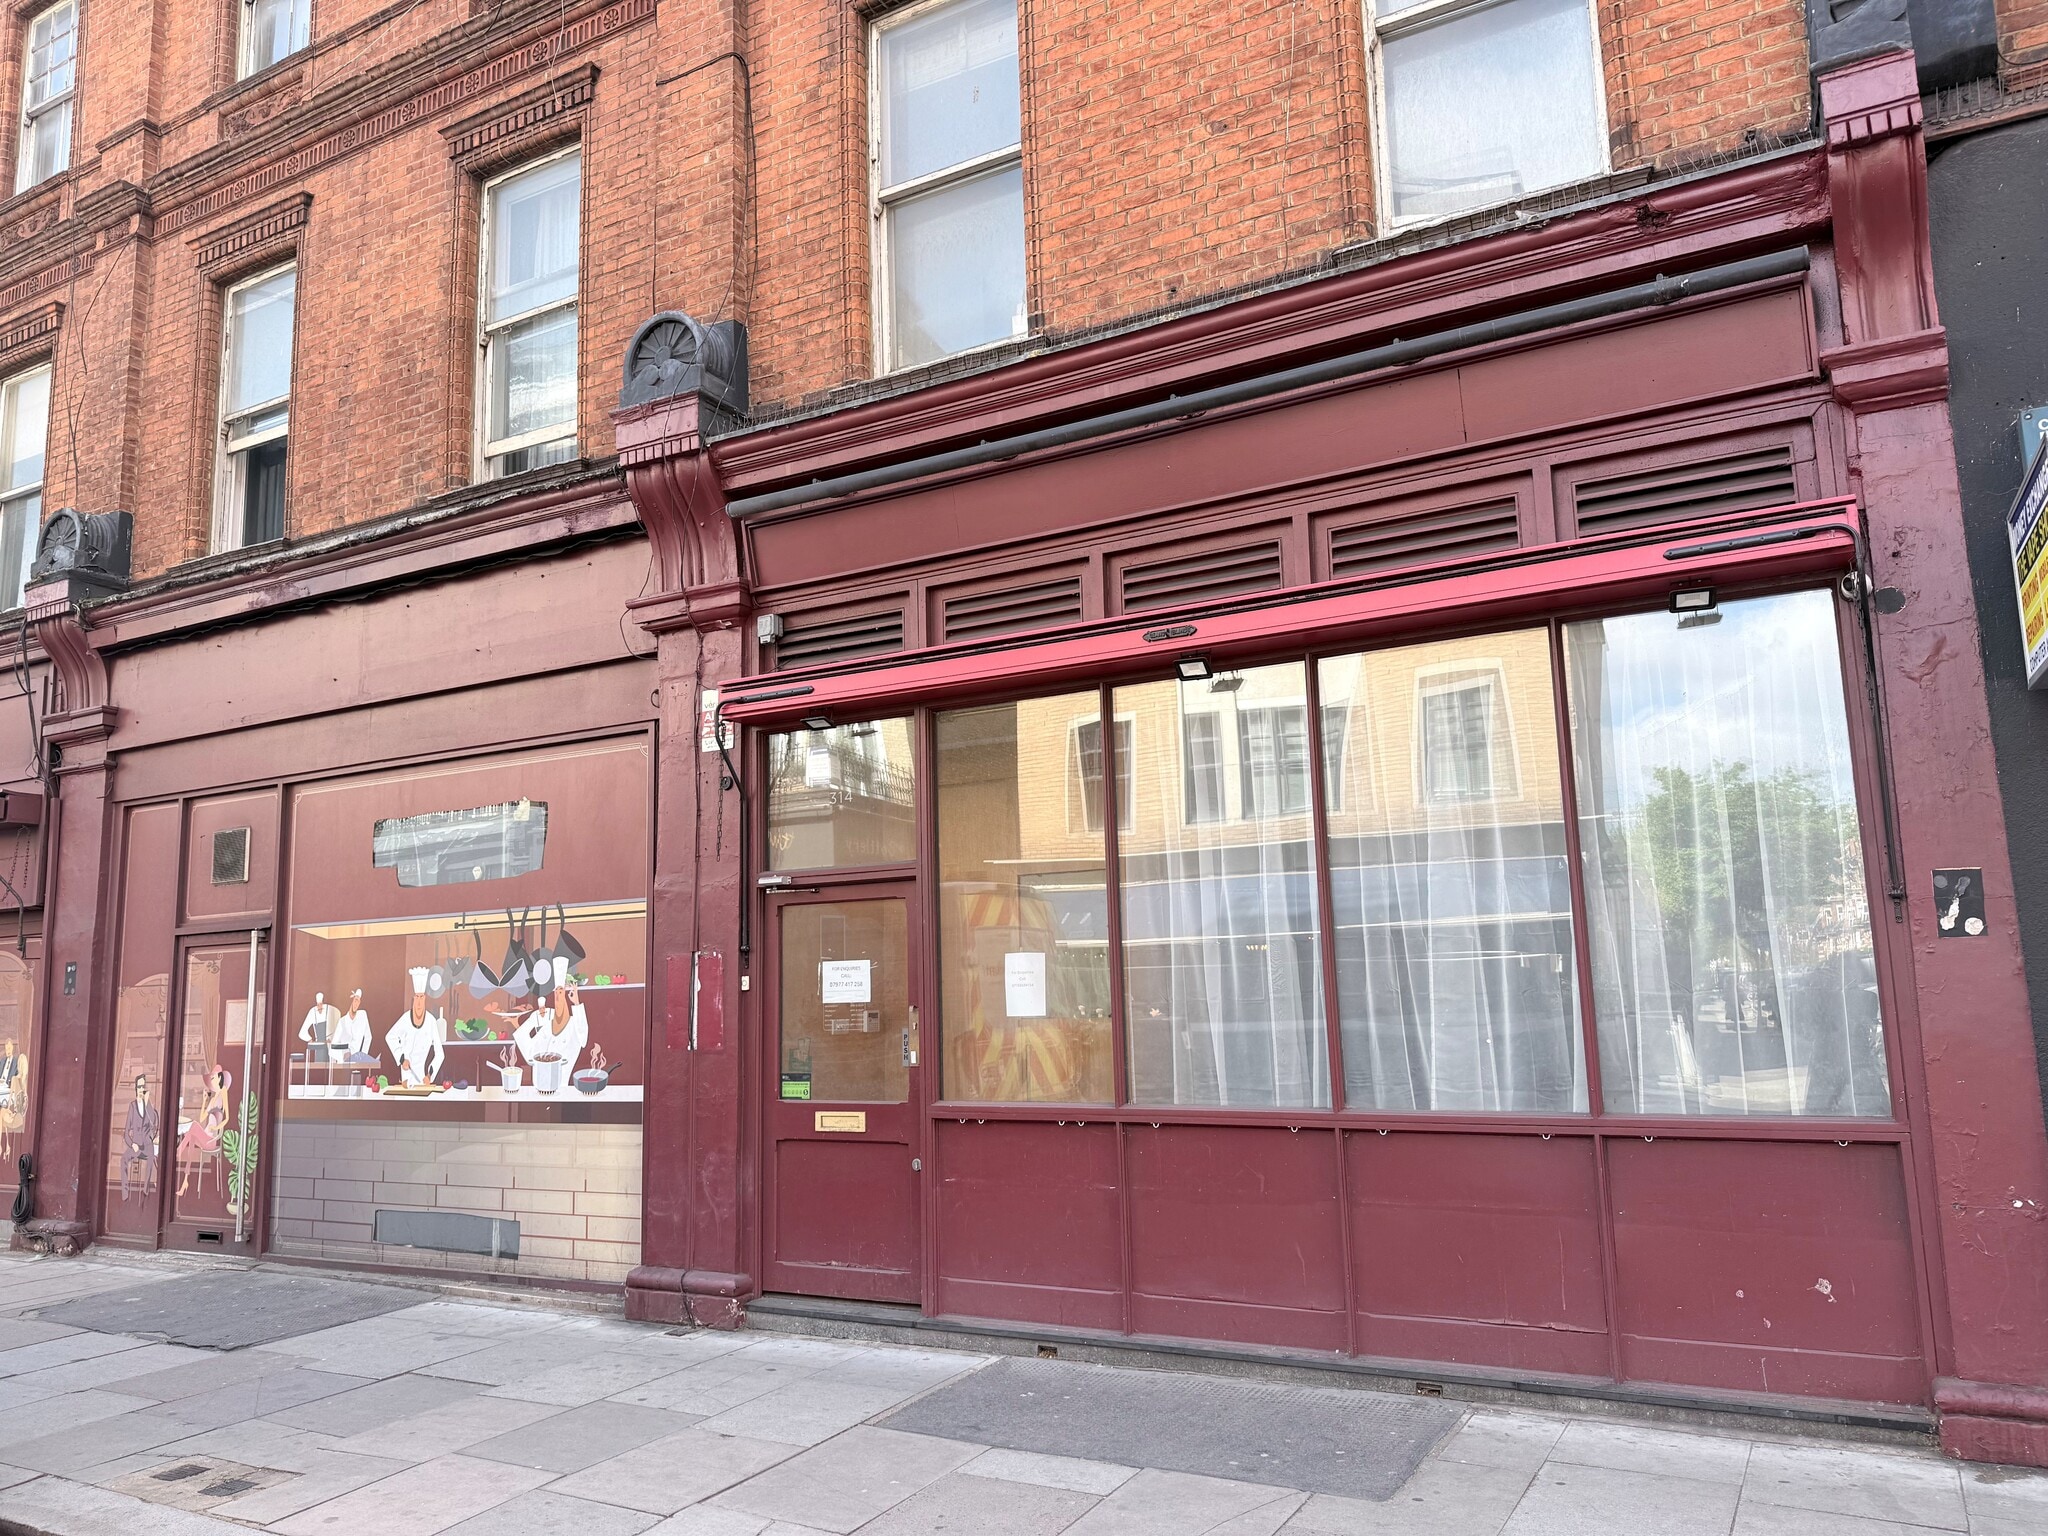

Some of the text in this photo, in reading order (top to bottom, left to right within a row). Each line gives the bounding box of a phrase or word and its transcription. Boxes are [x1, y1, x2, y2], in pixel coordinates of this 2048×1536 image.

[2017, 549, 2028, 584] THE
[2025, 525, 2039, 569] VAPE
[2029, 640, 2046, 672] COMPUTER
[829, 791, 853, 805] 314
